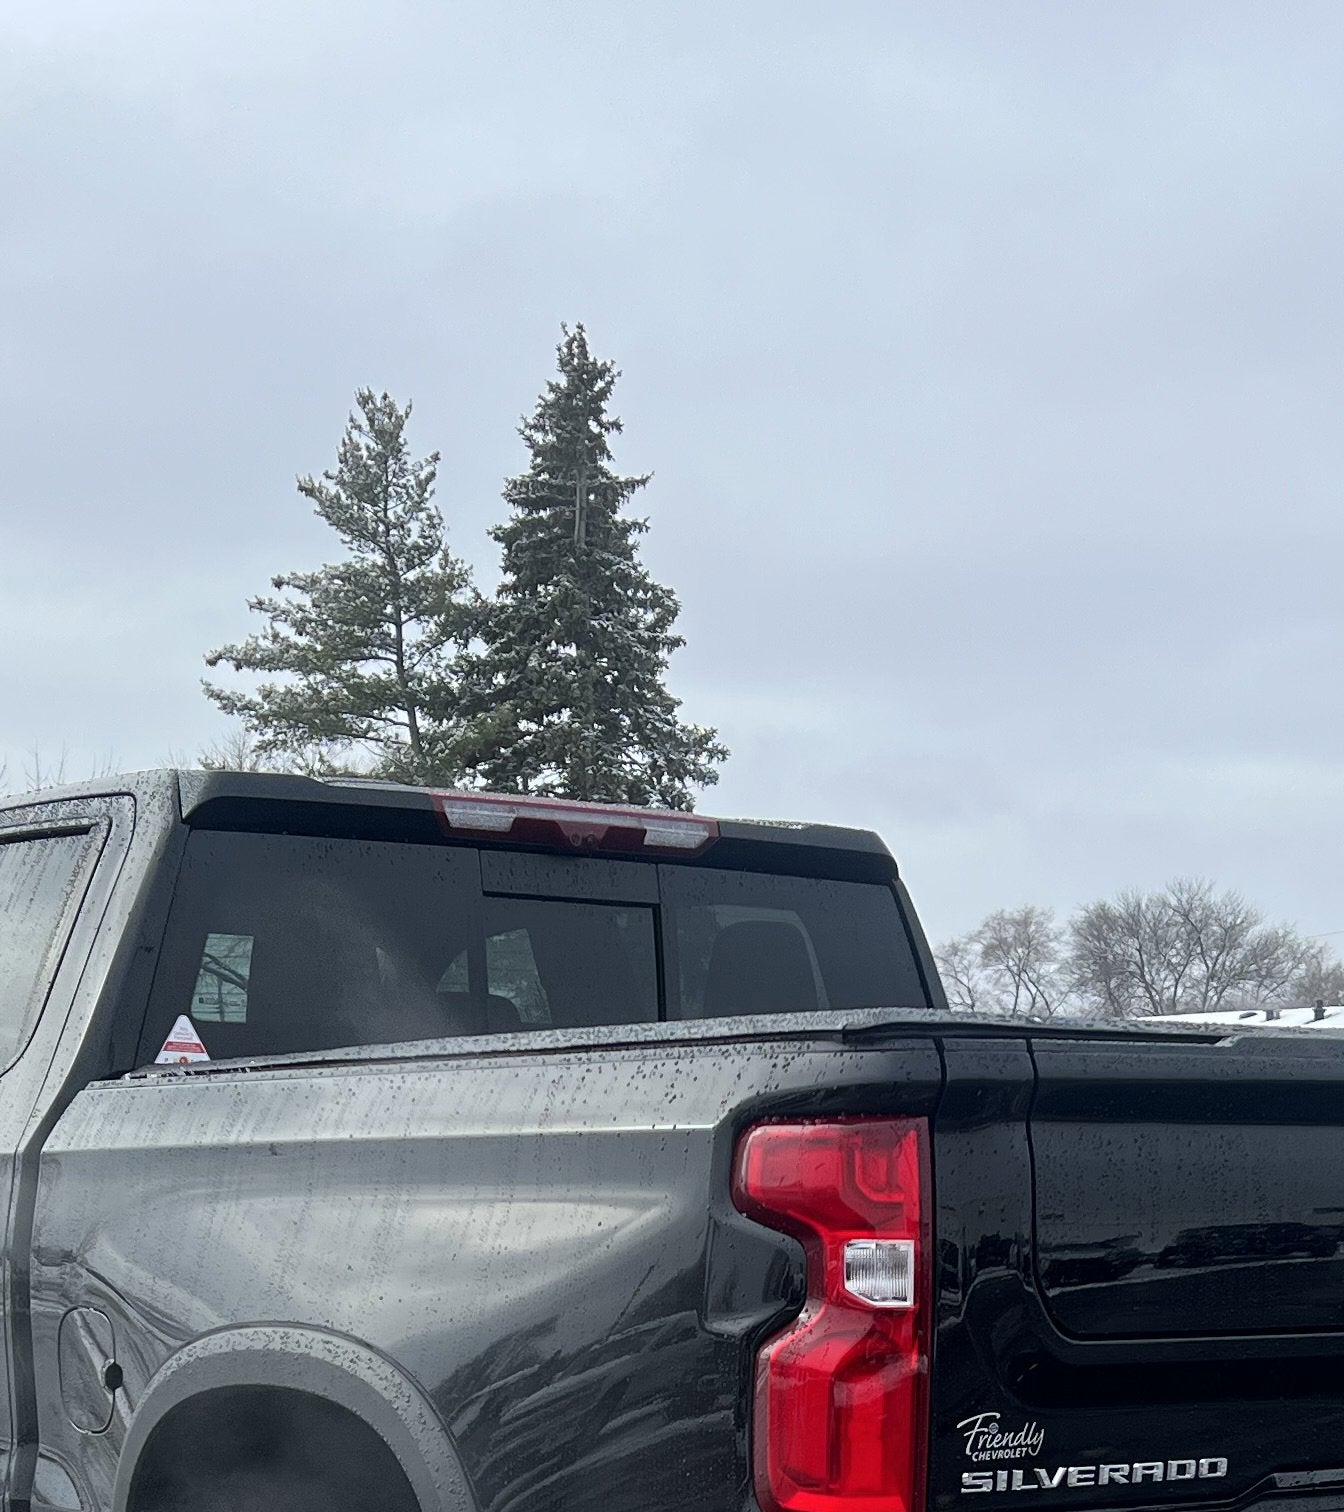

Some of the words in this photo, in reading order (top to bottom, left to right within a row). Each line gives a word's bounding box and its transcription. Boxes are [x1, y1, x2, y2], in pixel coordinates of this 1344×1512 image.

[956, 1412, 1045, 1457] Friendly
[972, 1447, 1028, 1462] CHEVROLET
[960, 1457, 1229, 1494] SILVERADO
